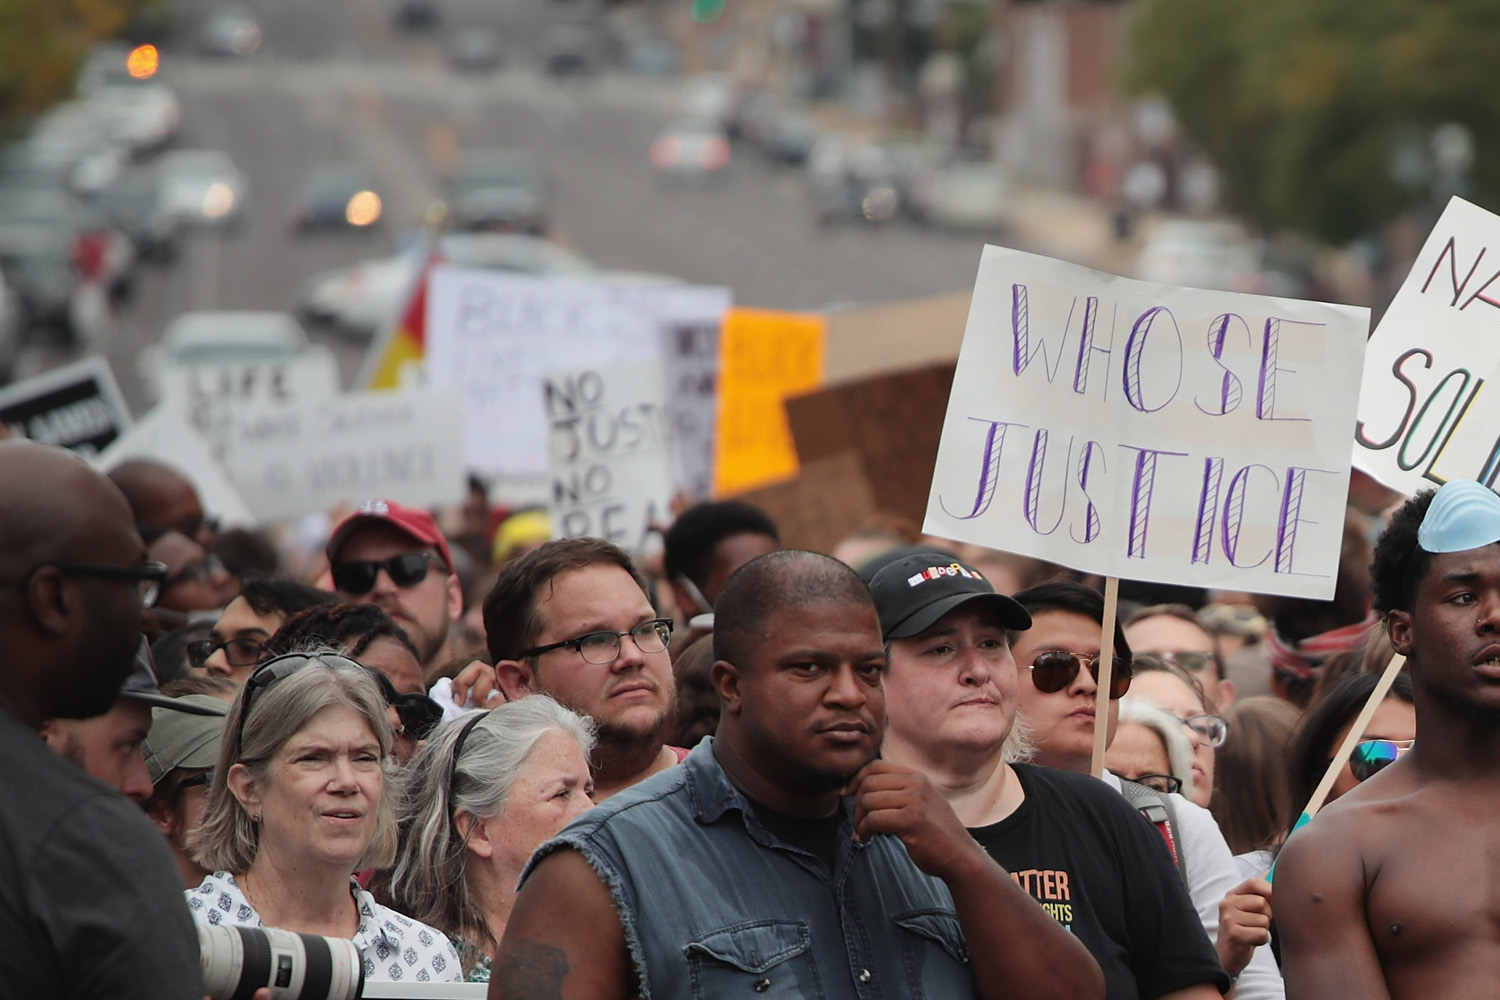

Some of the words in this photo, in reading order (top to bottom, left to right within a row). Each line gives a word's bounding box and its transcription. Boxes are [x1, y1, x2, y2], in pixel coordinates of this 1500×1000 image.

[543, 370, 604, 413] NO
[1011, 282, 1328, 421] WHOSE
[553, 463, 613, 503] NO
[938, 416, 1343, 579] JUSTICE
